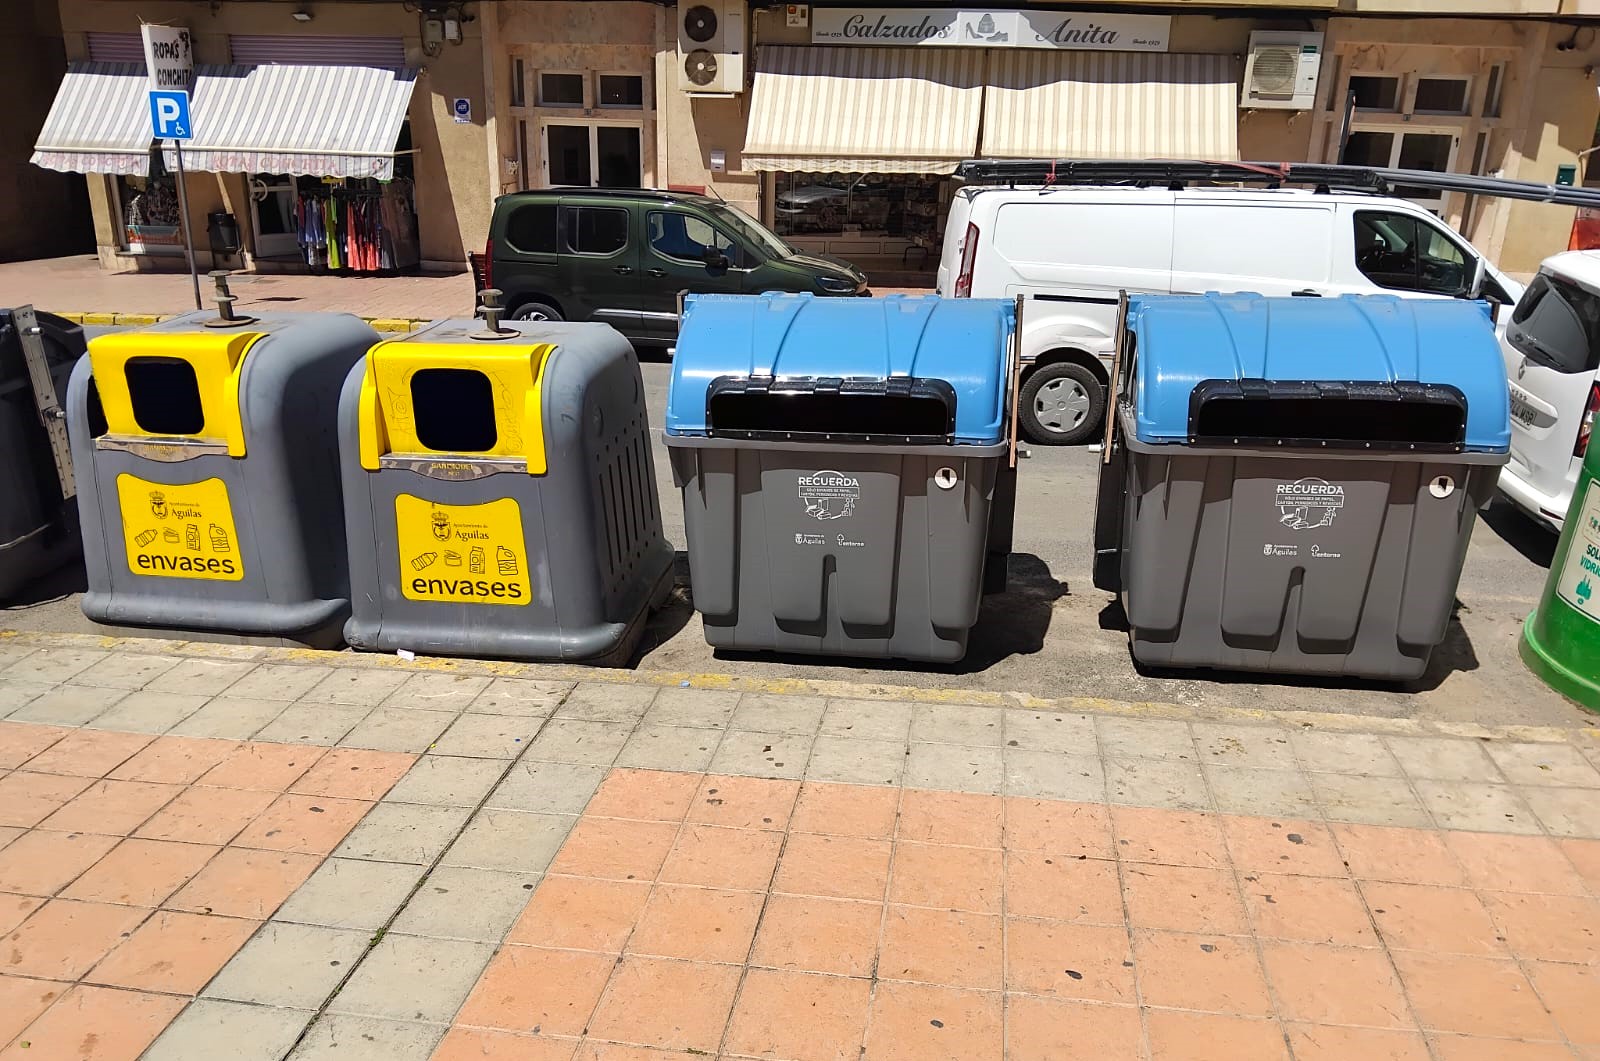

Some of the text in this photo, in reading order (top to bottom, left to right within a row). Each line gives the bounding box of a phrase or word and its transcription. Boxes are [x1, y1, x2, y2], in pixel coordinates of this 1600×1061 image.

[843, 15, 1119, 44] Calzados Anita
[153, 42, 180, 59] ROPAS
[157, 98, 180, 134] P
[798, 476, 860, 486] RECUERDA
[1276, 484, 1344, 494] RECUERDA
[1586, 544, 1600, 560] SOL
[137, 554, 236, 574] envases
[412, 578, 522, 598] envases
